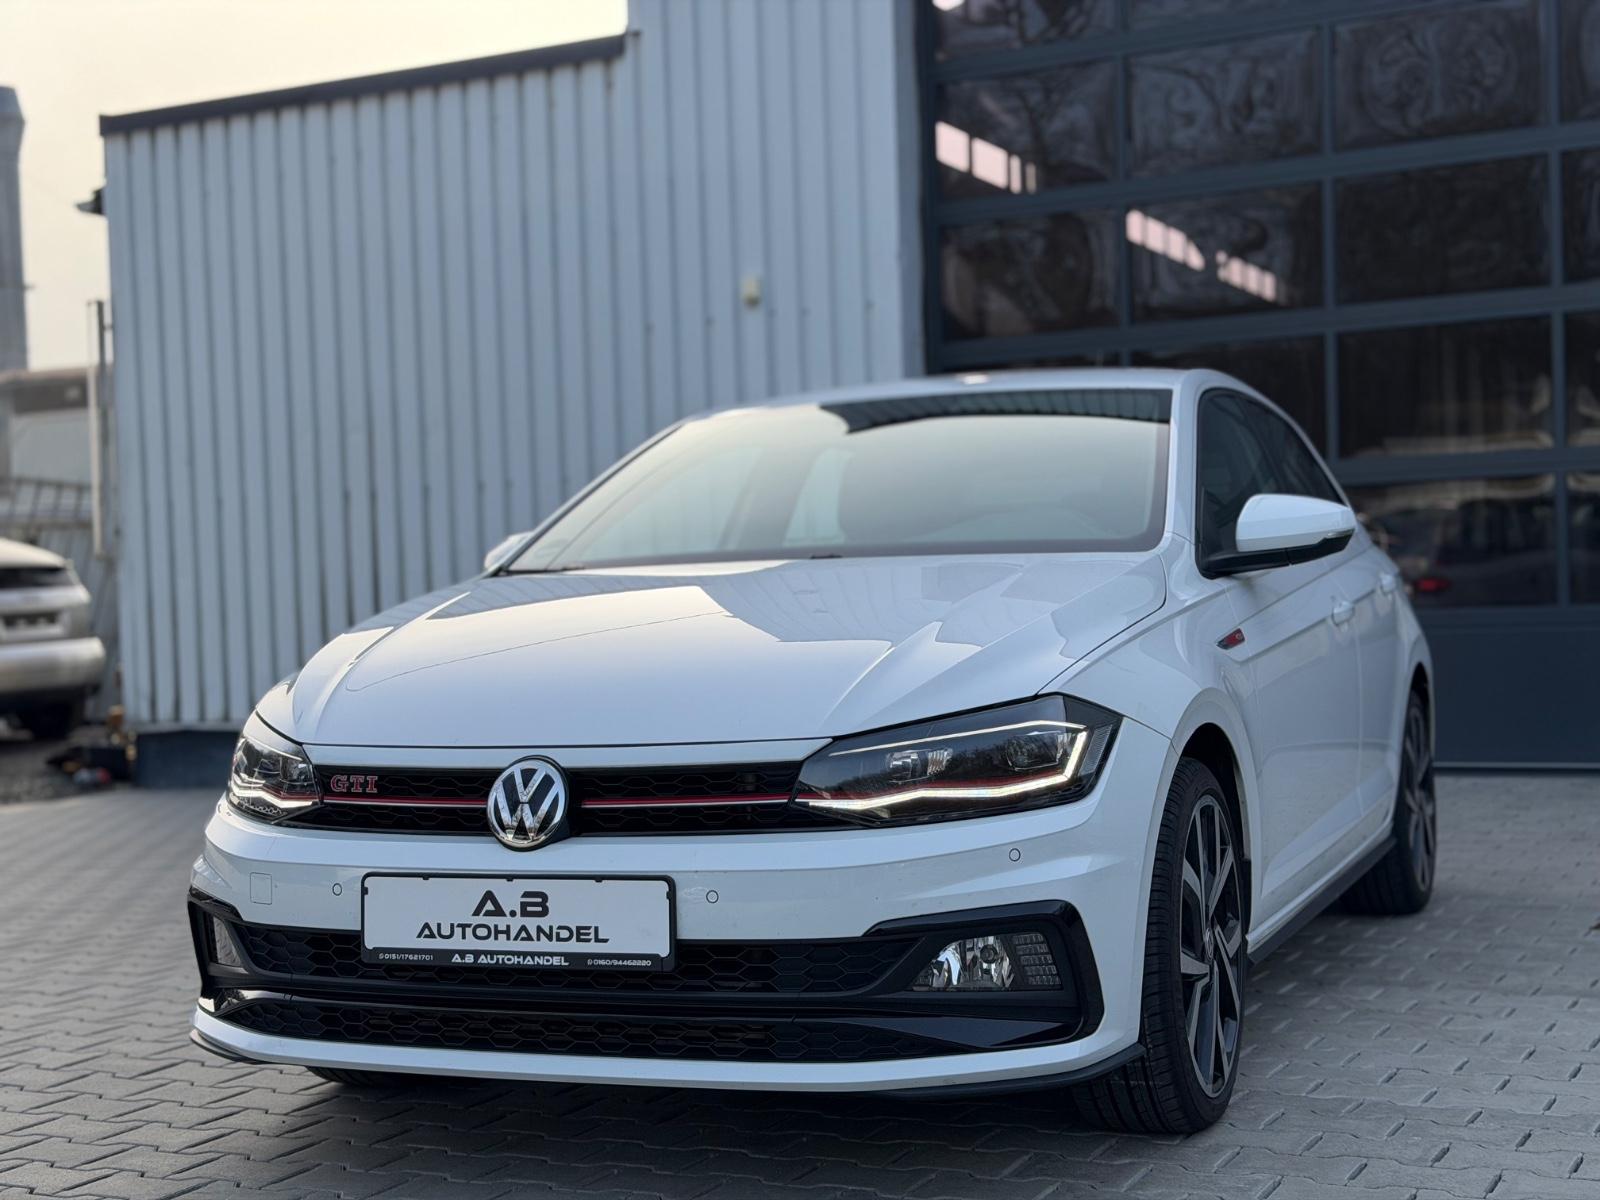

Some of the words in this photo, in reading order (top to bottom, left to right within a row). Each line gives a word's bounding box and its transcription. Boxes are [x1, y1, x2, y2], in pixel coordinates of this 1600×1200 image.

[330, 775, 378, 793] GTI
[471, 889, 550, 918] A.B
[416, 921, 610, 944] AUTOHANDEL
[451, 953, 475, 964] A.B
[477, 954, 570, 966] AUTOHANDEL
